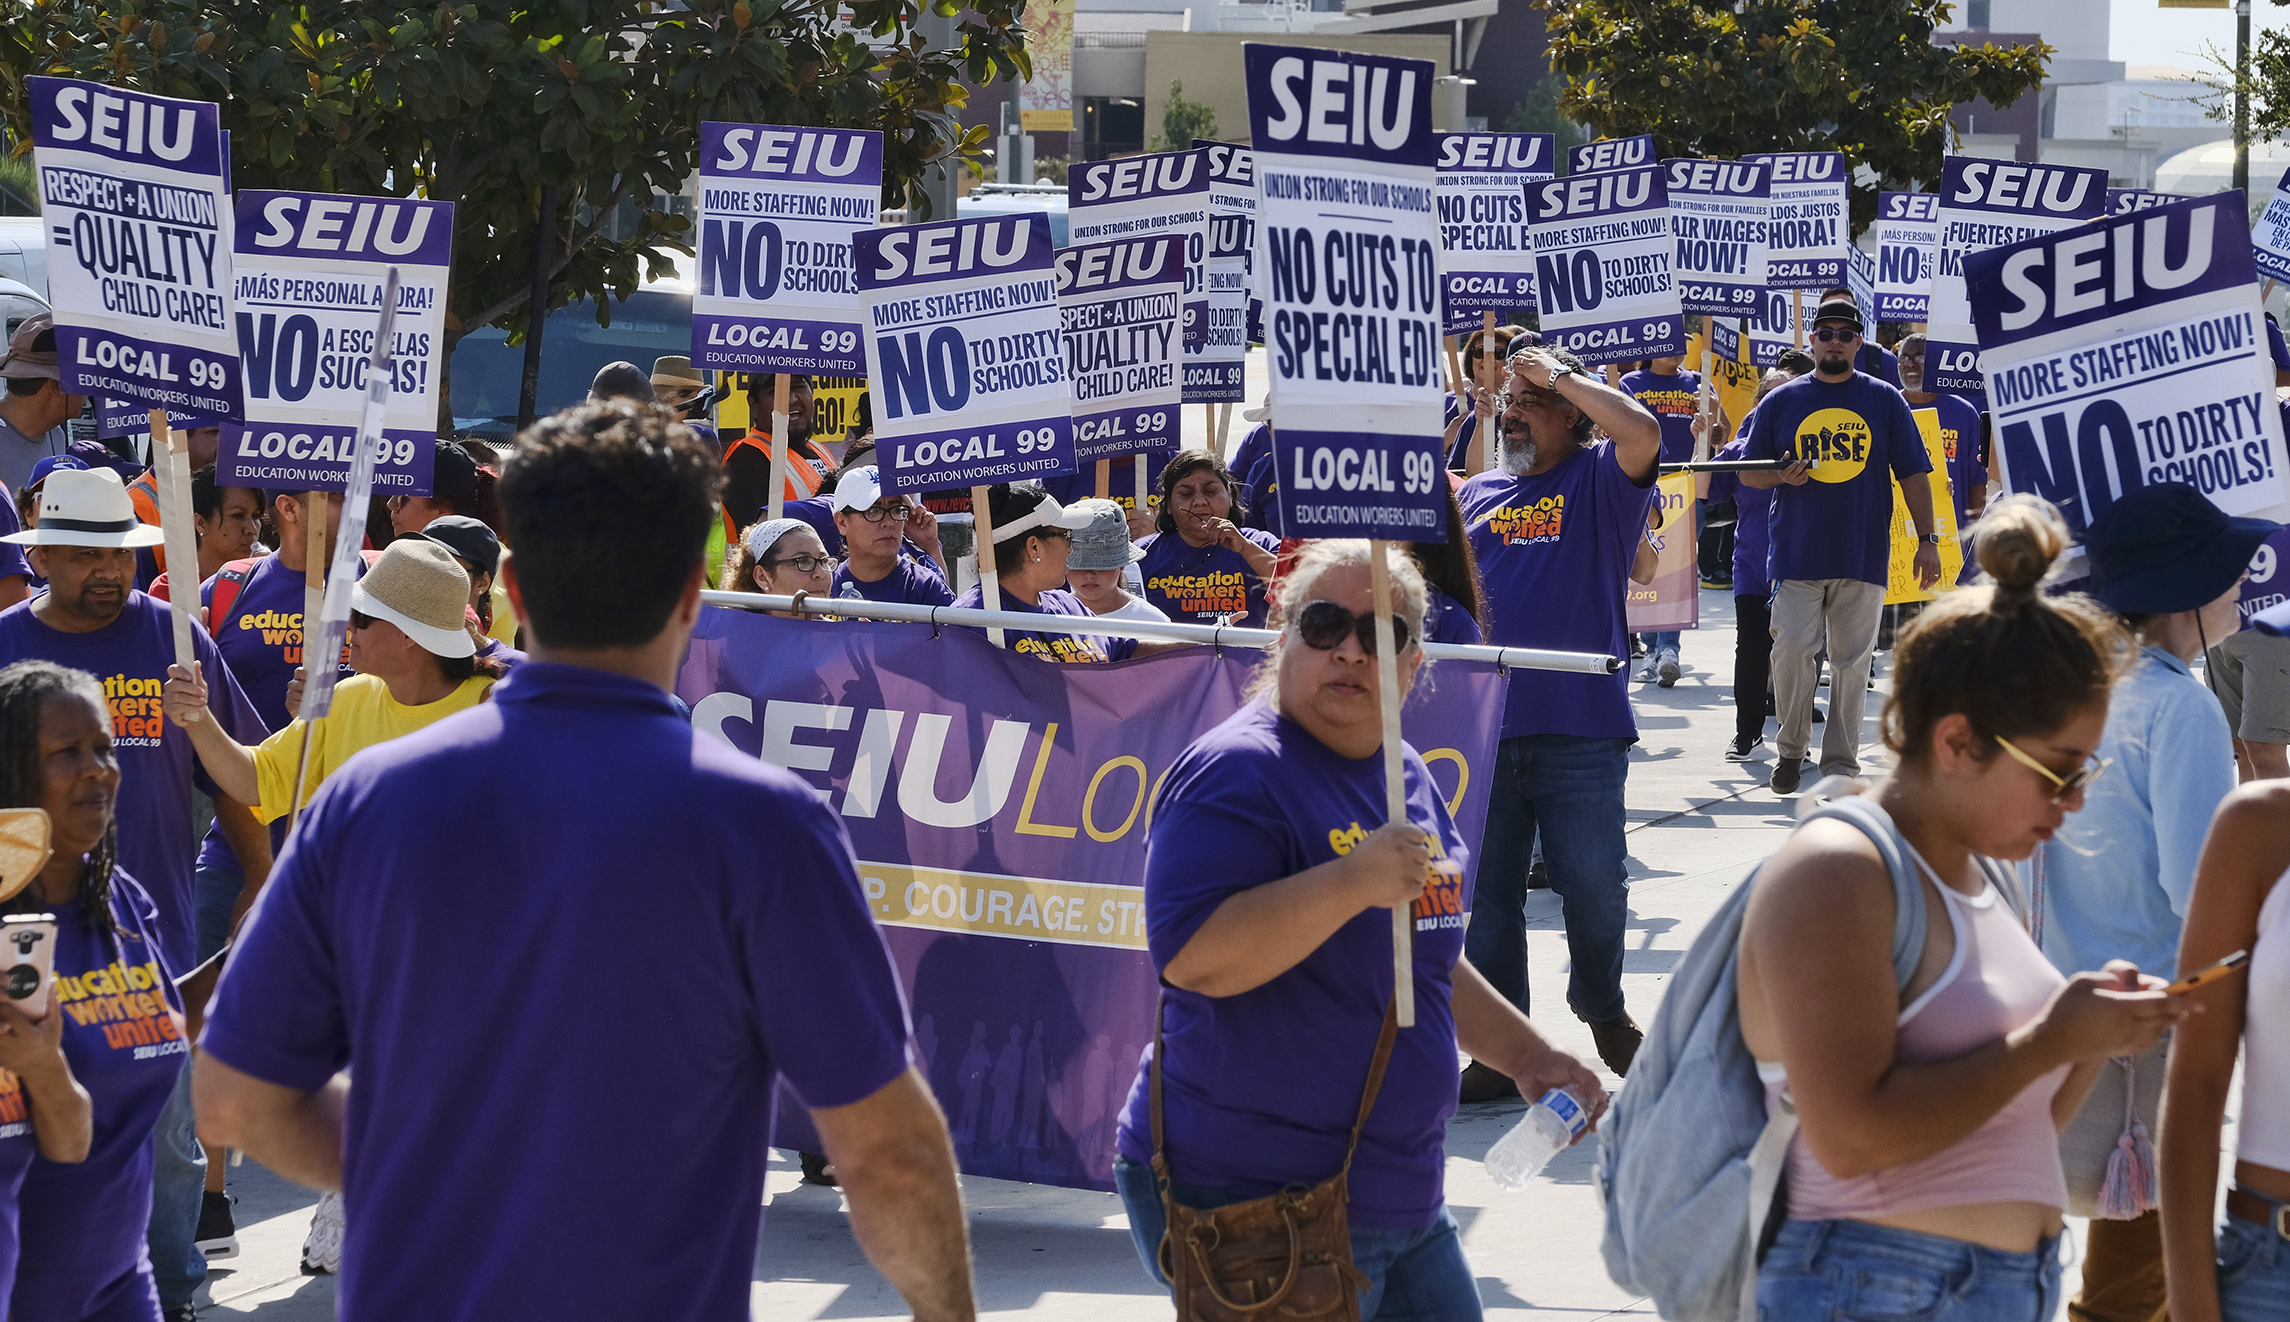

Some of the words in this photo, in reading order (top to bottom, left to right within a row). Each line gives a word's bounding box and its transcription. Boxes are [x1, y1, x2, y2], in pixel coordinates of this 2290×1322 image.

[1268, 57, 1415, 150] SEIU
[52, 86, 196, 162] SEIU
[716, 128, 866, 177] SEIU
[1438, 137, 1541, 168] SEIU
[1576, 138, 1646, 172] SEIU
[1081, 153, 1197, 201] SEIU
[1461, 176, 1488, 187] STRONG
[1490, 177, 1503, 185] FOR
[1504, 177, 1518, 186] OUR
[1667, 161, 1761, 193] SEIU
[1954, 162, 2092, 212] SEIU
[45, 169, 123, 207] RESPECT
[137, 186, 153, 215] A
[155, 188, 215, 226] UNION
[705, 190, 750, 211] MORE
[753, 192, 826, 217] STAFFING
[830, 196, 874, 219] NOW!
[1215, 195, 1244, 208] STRONG
[1264, 173, 1301, 199] UNION
[1304, 176, 1349, 202] STRONG
[1352, 182, 1369, 205] FOR
[1370, 183, 1389, 207] OUR
[1391, 185, 1431, 213] SCHOOLS
[1539, 171, 1652, 218] SEIU
[1683, 201, 1707, 211] STRONG
[1708, 203, 1719, 212] FOR
[1721, 205, 1734, 213] OUR
[1735, 205, 1767, 215] FAMILIES
[1781, 190, 1810, 199] NUESTRAS
[1811, 188, 1839, 197] FAMILIAS
[1074, 225, 1101, 239] UNION
[1102, 222, 1134, 237] STRONG
[1135, 219, 1151, 233] FOR
[1152, 217, 1167, 231] OUR
[1169, 210, 1204, 229] SCHOOLS
[1437, 195, 1466, 223] NO
[1471, 195, 1522, 223] CUTS
[1800, 202, 1840, 218] JUSTOS
[255, 197, 432, 256] SEIU
[1441, 226, 1517, 251] SPECIAL
[1533, 231, 1568, 248] MORE
[1572, 221, 1629, 244] STAFFING
[1630, 216, 1667, 236] NOW!
[1703, 218, 1767, 244] WAGES
[1769, 218, 1836, 249] HORA!
[1881, 229, 1901, 242] ¡MÁS
[1942, 221, 2012, 246] ¡FUERTES
[700, 219, 782, 301] NO
[785, 241, 808, 267] TO
[875, 219, 1031, 280] SEIU
[1676, 238, 1748, 275] NOW!
[1879, 245, 1919, 284] NO
[1055, 239, 1169, 292] SEIU
[1226, 273, 1243, 288] NOW!
[1268, 226, 1316, 307] NO
[1325, 229, 1398, 311] CUTS
[1401, 238, 1435, 314] TO
[1602, 259, 1622, 279] TO
[1624, 252, 1669, 275] DIRTY
[1818, 262, 1838, 275] 99
[2000, 205, 2216, 331] SEIU
[234, 273, 279, 301] ¡MÁS
[283, 279, 368, 306] PERSONAL
[1448, 277, 1509, 294] OCAL
[1535, 249, 1603, 315] NO
[1604, 273, 1672, 299] SCHOOLS!
[1732, 288, 1756, 304] 99
[102, 278, 161, 319] CHILD
[165, 289, 225, 331] CARE!
[872, 300, 923, 326] MORE
[925, 286, 1008, 319] STAFFING
[1010, 280, 1056, 306] NOW!
[1114, 302, 1124, 324] A
[1128, 294, 1175, 321] UNION
[1219, 308, 1242, 326] DIRTY
[1481, 299, 1513, 307] WORKERS
[1699, 305, 1730, 314] WORKERS
[1731, 306, 1756, 315] UNITED
[322, 328, 335, 352] A
[707, 323, 809, 350] LOCAL
[820, 330, 856, 353] 99
[969, 339, 995, 367] TO
[998, 328, 1060, 366] DIRTY
[1207, 327, 1242, 347] SCHOOLS!
[1275, 309, 1395, 384] SPECIAL
[1399, 318, 1438, 388] ED!
[1556, 326, 1635, 351] LOCAL
[1642, 321, 1671, 341] 99
[1729, 334, 1736, 349] 99
[77, 338, 178, 382] LOCAL
[188, 359, 226, 391] 99
[235, 312, 319, 402] NO
[706, 352, 765, 366] EDUCATION
[767, 354, 816, 368] WORKERS
[818, 357, 856, 370] UNITED
[1605, 347, 1641, 361] WORKERS
[1641, 343, 1674, 357] UNITED
[1993, 368, 2062, 406] MORE
[2070, 336, 2179, 389] STAFFING
[2184, 312, 2255, 356] NOW!
[877, 326, 970, 419] NO
[973, 357, 1065, 395] SCHOOLS!
[1076, 371, 1125, 401] CHILD
[1127, 363, 1173, 392] CARE!
[1181, 367, 1223, 386] LOCAL
[1228, 367, 1241, 385] 99
[78, 373, 138, 396] EDUCATION
[138, 386, 189, 406] WORKERS
[190, 395, 230, 413] UNITED
[814, 397, 845, 435] GO!
[1135, 411, 1167, 434] 99
[1836, 422, 1865, 432] SEIU
[2138, 417, 2175, 463] TO
[2182, 391, 2263, 453] DIRTY
[237, 431, 354, 463] LOCAL
[374, 438, 415, 465] 99
[895, 433, 1005, 469] LOCAL
[1016, 427, 1055, 455] 99
[1094, 440, 1133, 454] WORKERS
[1134, 437, 1168, 449] UNITED
[1800, 426, 1867, 462] RISE
[235, 466, 307, 480] EDUCATION
[371, 473, 414, 486] UNITED
[897, 471, 961, 488] EDUCATION
[962, 463, 1016, 482] WORKERS
[1018, 457, 1060, 474] UNITED
[1294, 447, 1395, 492] LOCAL
[1403, 451, 1434, 494] 99
[2000, 398, 2145, 530] NO
[2147, 439, 2274, 496] SCHOOLS!
[1296, 505, 1359, 524] EDUCATION
[1361, 505, 1404, 526] WORKERS
[1406, 509, 1436, 527] UNITED
[1510, 536, 1528, 545] SEIU
[1148, 570, 1245, 589] education
[1165, 584, 1246, 599] workers
[1181, 595, 1246, 612] united
[121, 737, 149, 747] LOCAL
[150, 738, 161, 748] 99
[691, 692, 1030, 828] SEIU
[904, 881, 1088, 934] COURAGE.
[134, 1045, 157, 1060] SEIU
